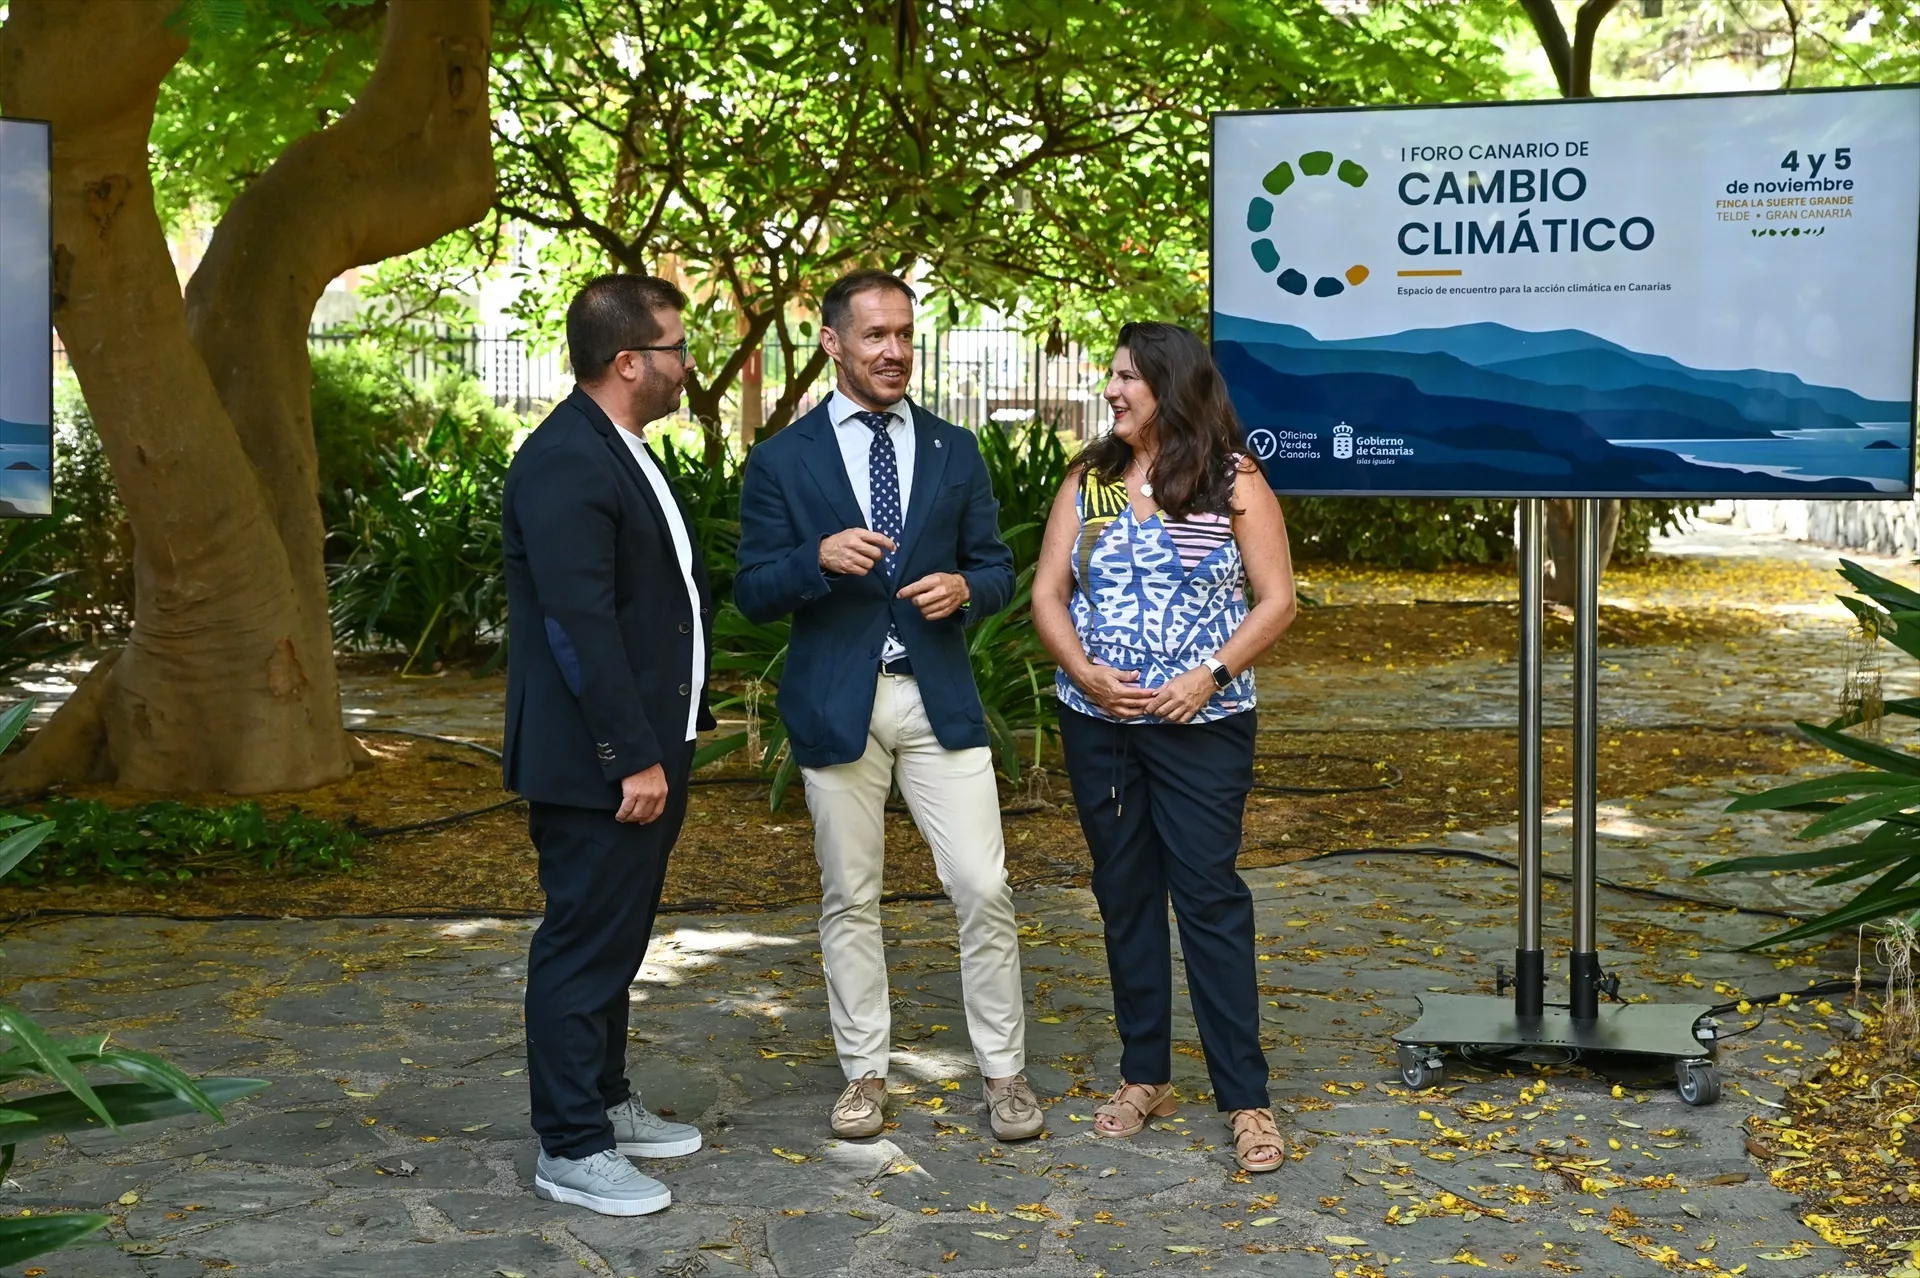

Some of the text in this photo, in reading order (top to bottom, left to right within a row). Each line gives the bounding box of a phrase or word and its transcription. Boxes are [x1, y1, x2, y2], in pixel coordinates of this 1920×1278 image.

[1401, 141, 1589, 162] I FORO CANARIO DE
[1780, 147, 1852, 179] 4 y 5
[1398, 167, 1587, 206] CAMBIO
[1726, 177, 1854, 194] de noviembre
[1716, 196, 1854, 208] FINCA LA SUERTE GRANDE
[1716, 208, 1853, 221] TELDE GRAN CANARIA
[1397, 208, 1655, 256] CLIMÁTICO
[1397, 282, 1672, 296] Espacio de encuentro para la acción climática en Canarias
[1279, 430, 1318, 440] Oficinas
[1356, 436, 1404, 446] Gobierno
[1279, 440, 1312, 449] Verdes
[1279, 450, 1321, 459] Canarias
[1356, 446, 1414, 456] de Canarias
[1356, 457, 1396, 466] islas iguales
